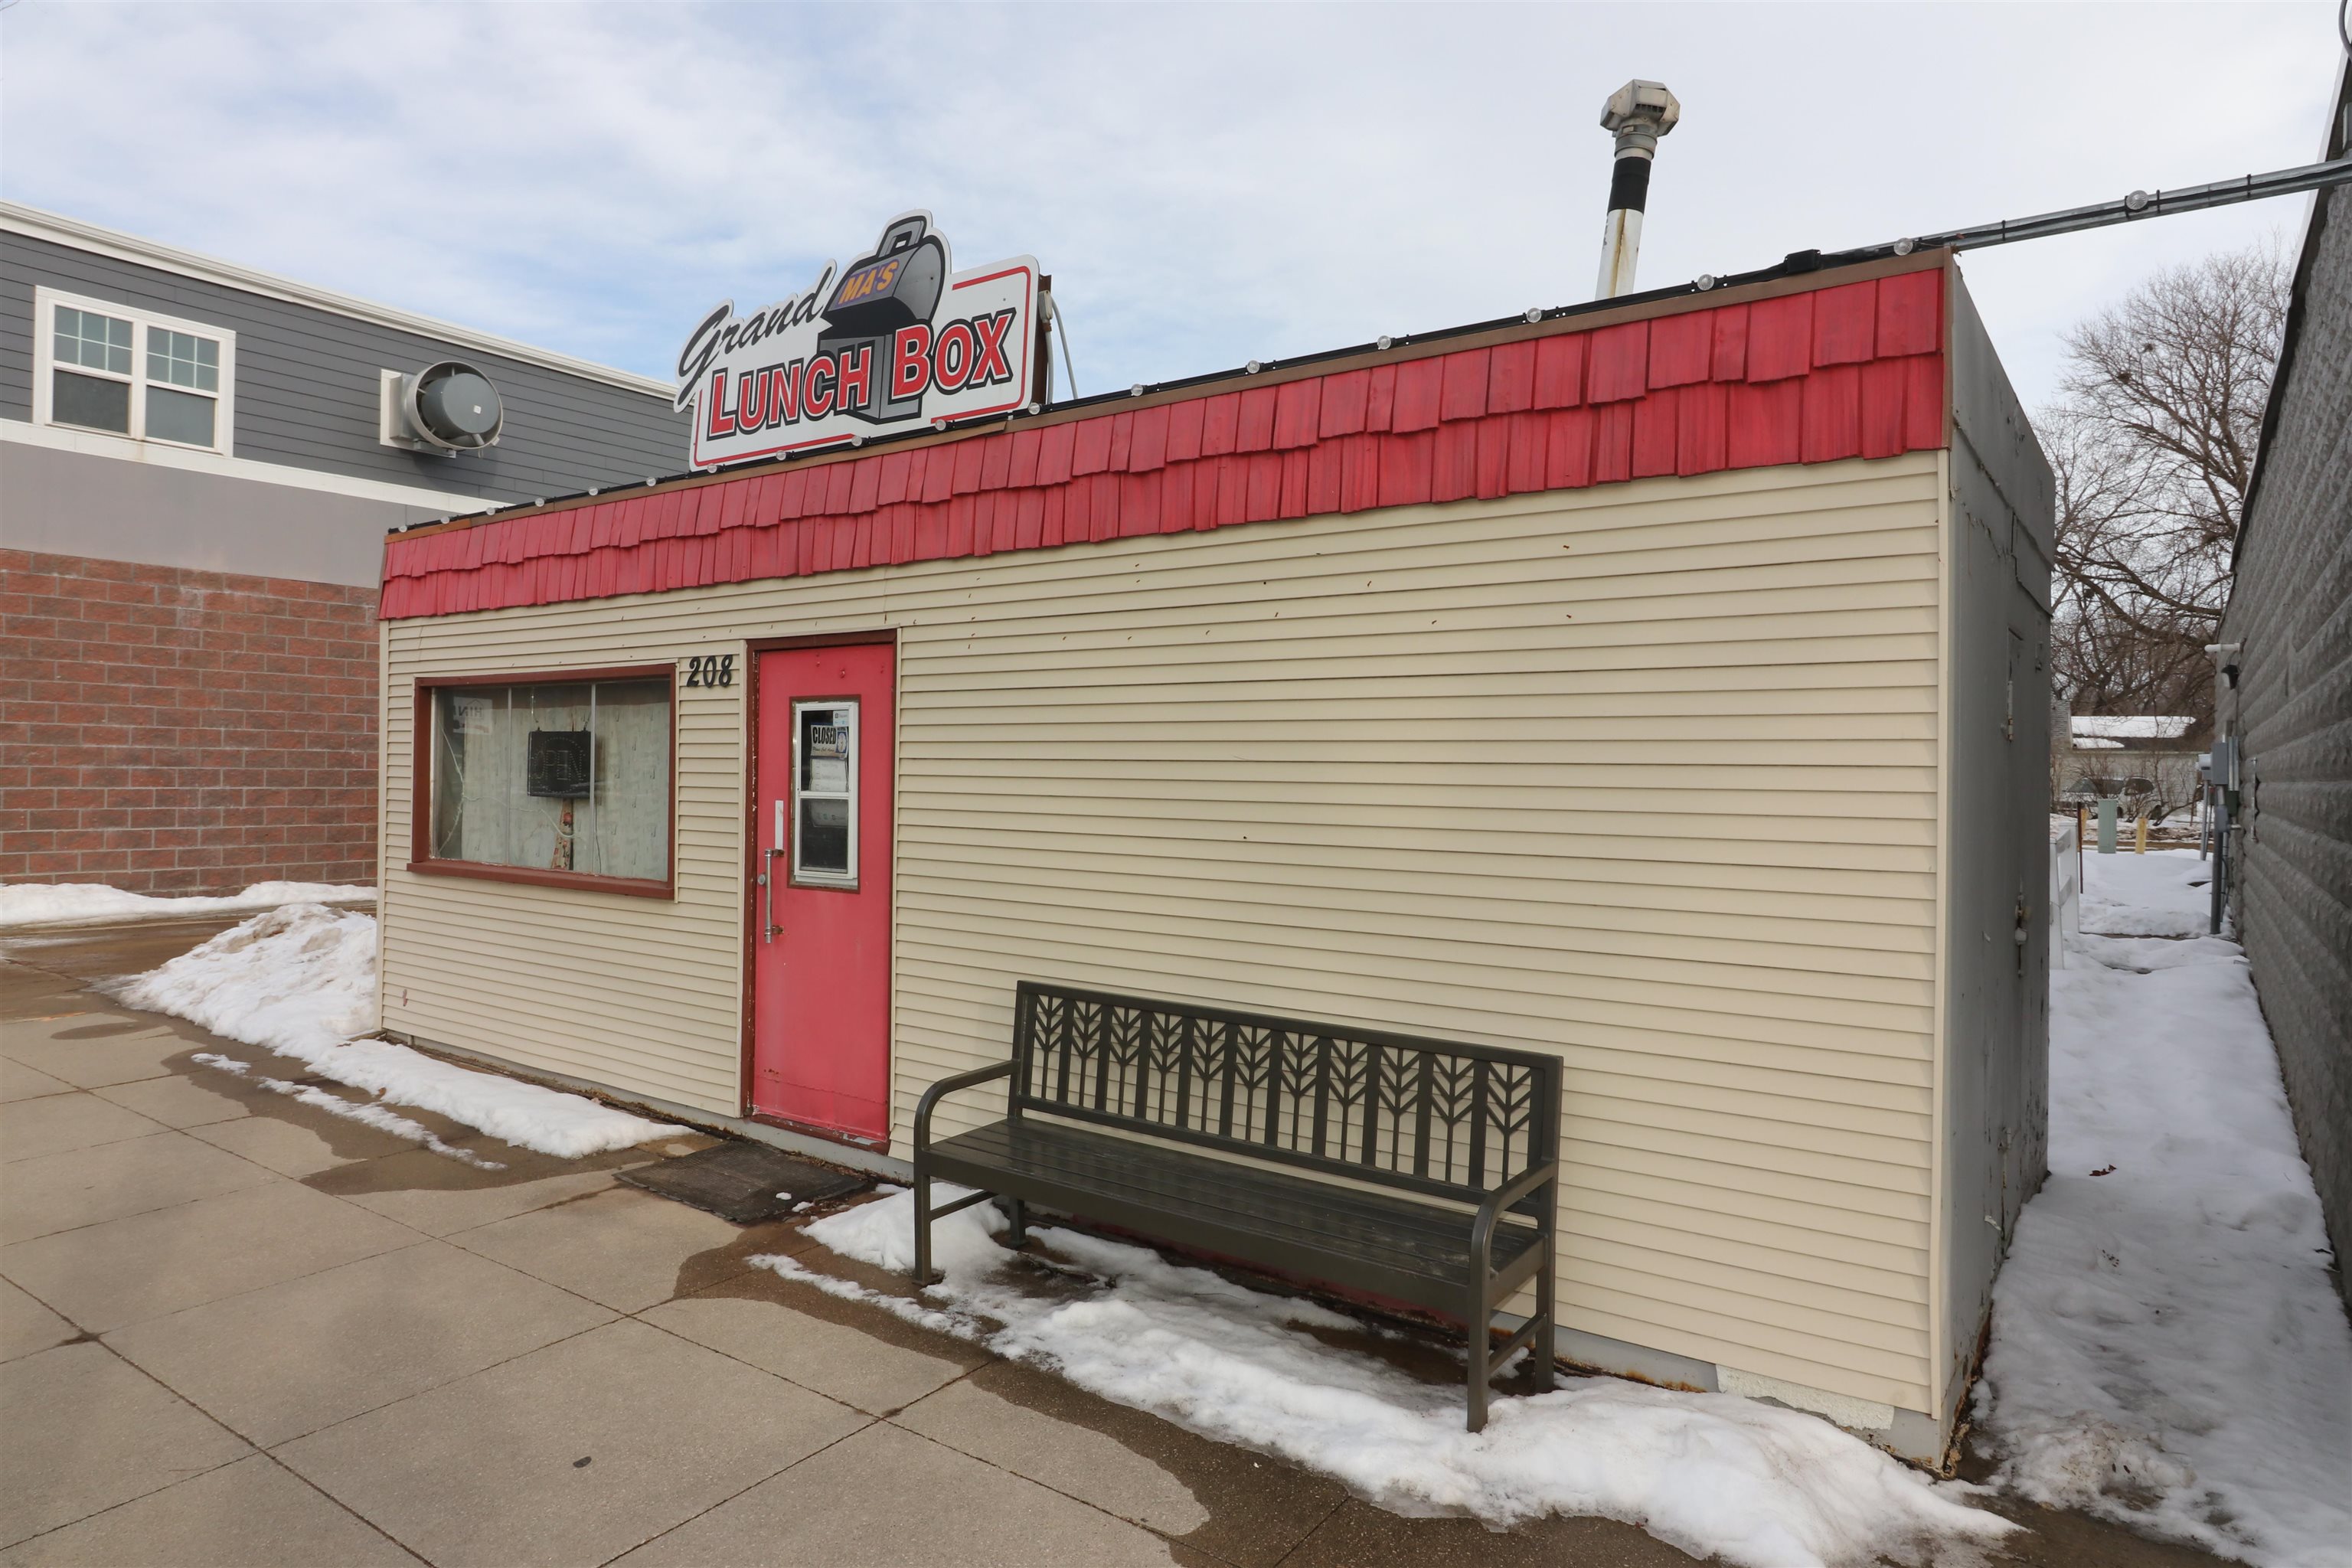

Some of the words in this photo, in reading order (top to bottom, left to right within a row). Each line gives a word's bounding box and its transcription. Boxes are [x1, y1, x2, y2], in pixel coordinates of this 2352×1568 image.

[838, 260, 898, 304] MA'S
[678, 266, 832, 406] Grand
[708, 341, 874, 439] LUNCH
[889, 309, 1016, 405] BOX
[687, 655, 733, 688] 208
[812, 727, 837, 744] CLOSED
[534, 750, 583, 780] OPEN
